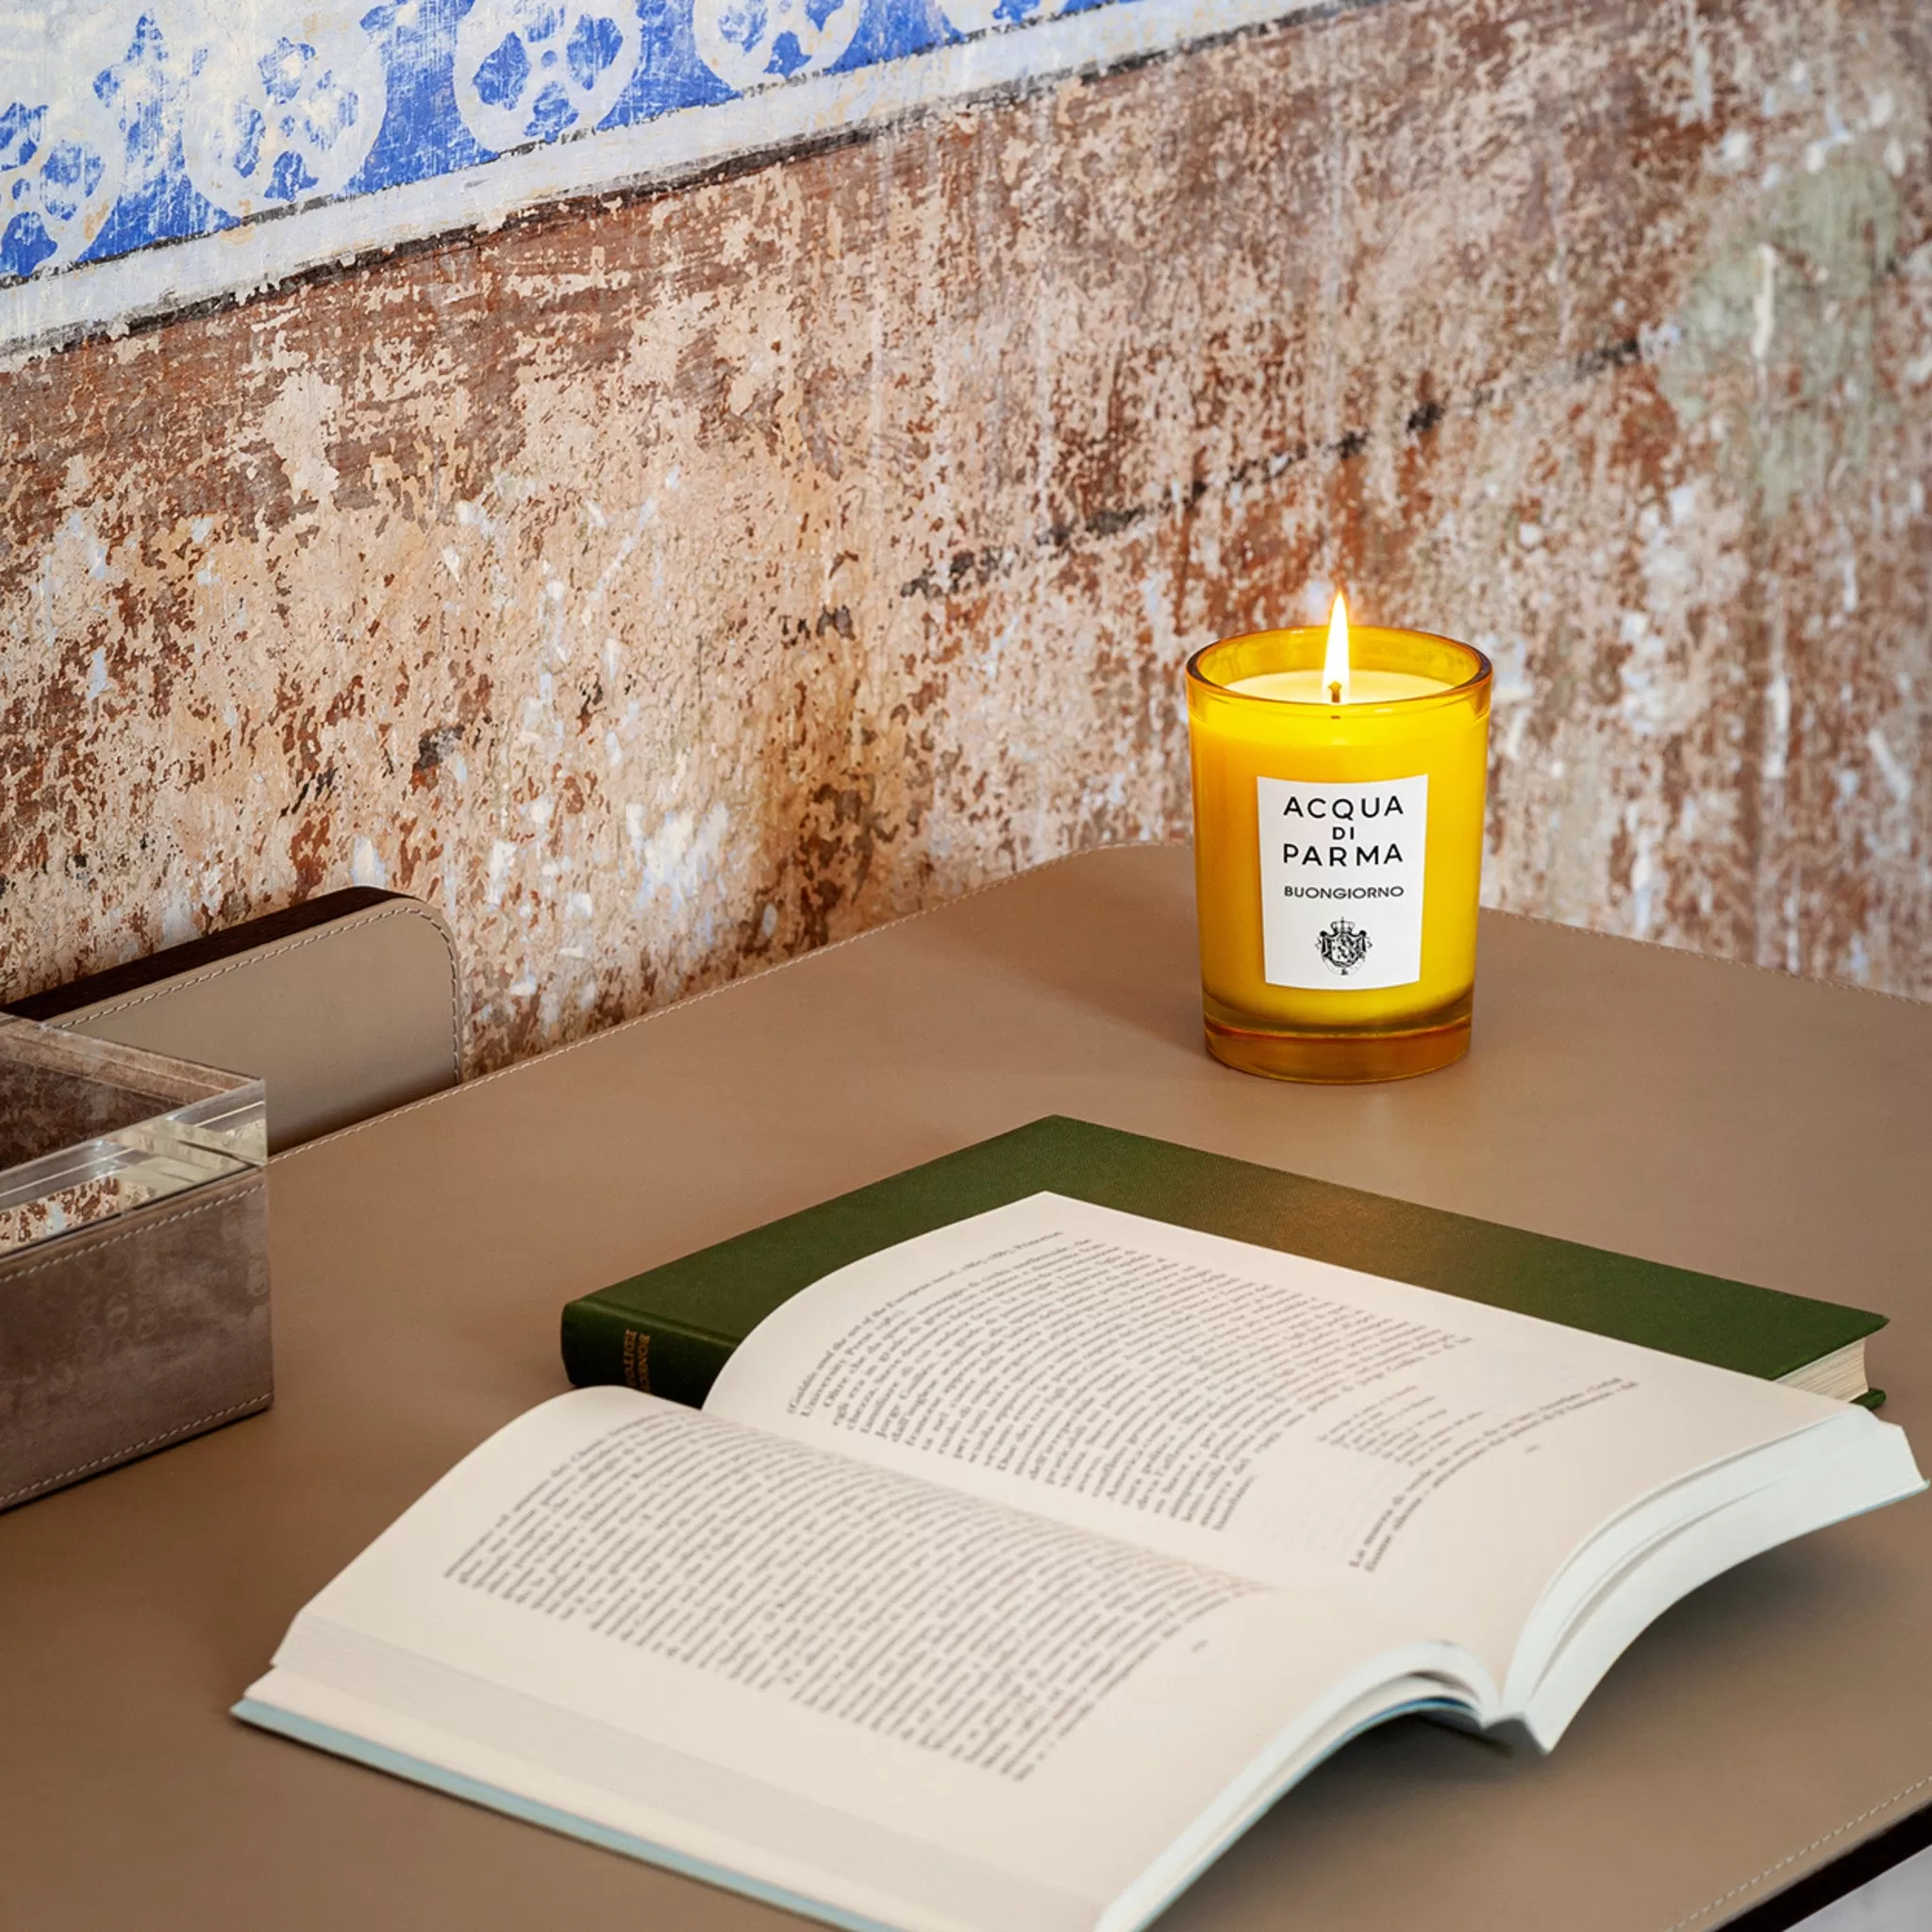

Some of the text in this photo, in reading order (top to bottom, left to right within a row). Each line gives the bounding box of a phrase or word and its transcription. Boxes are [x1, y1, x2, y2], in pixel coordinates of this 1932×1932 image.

[1283, 795, 1404, 821] ACQUA
[1332, 826, 1355, 841] DI
[1283, 843, 1404, 867] PARMA
[1284, 886, 1405, 900] BUONGIORNO
